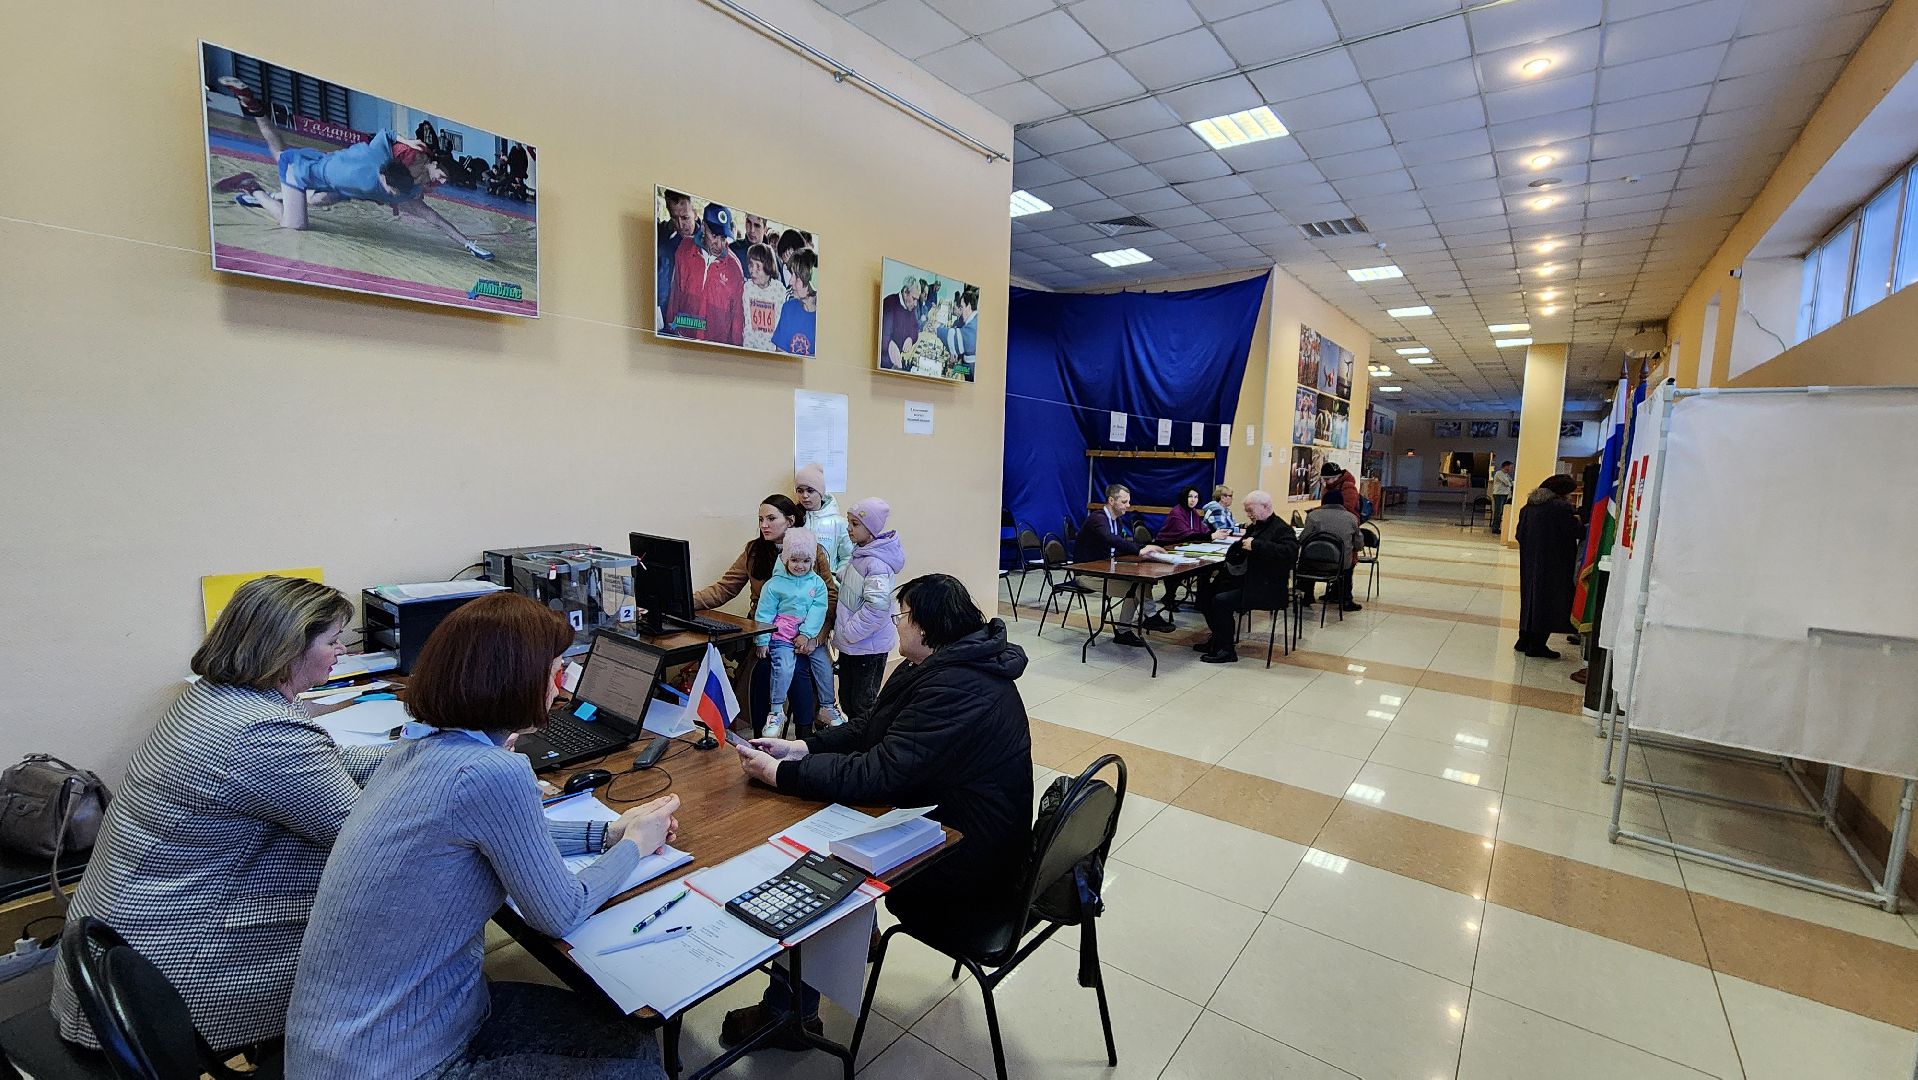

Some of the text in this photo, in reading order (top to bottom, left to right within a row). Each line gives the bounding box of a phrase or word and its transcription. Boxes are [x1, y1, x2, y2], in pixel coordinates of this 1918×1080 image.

[752, 308, 772, 327] 6916
[623, 609, 631, 618] 2
[572, 615, 580, 627] 1
